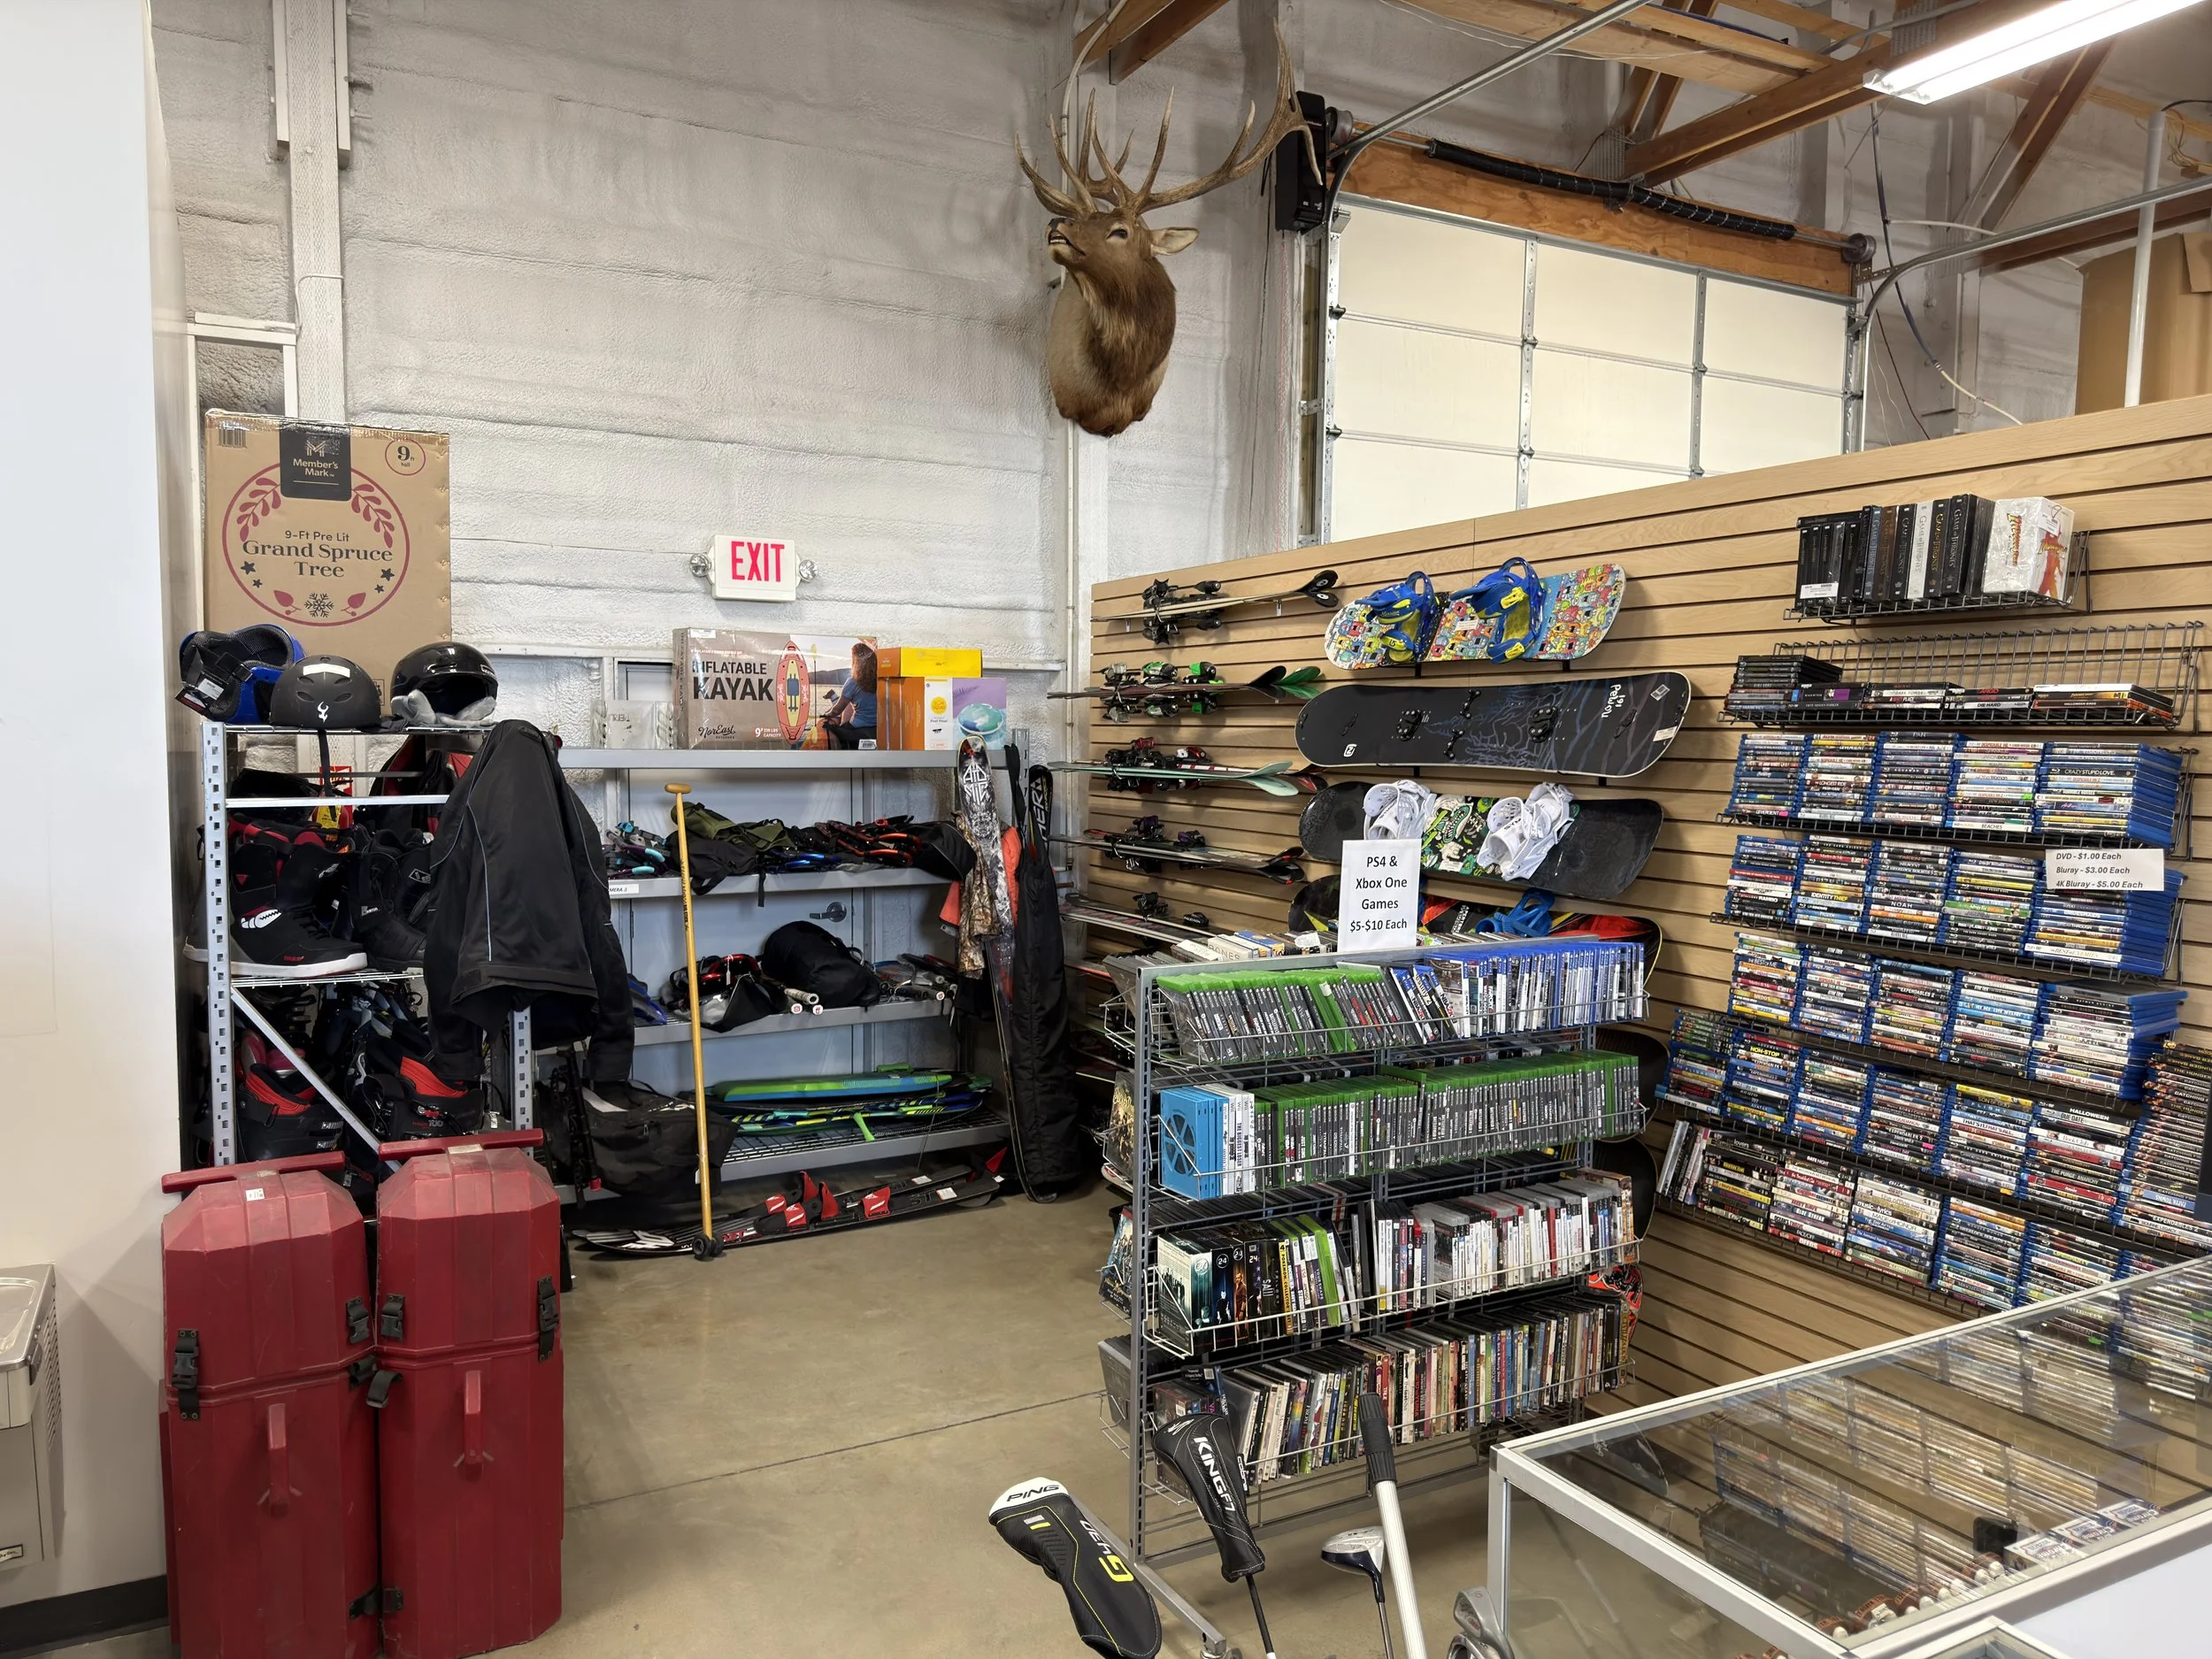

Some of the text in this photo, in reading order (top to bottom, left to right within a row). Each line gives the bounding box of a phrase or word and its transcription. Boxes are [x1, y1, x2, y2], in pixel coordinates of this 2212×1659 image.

[398, 445, 410, 461] 9
[293, 458, 339, 470] Member's
[305, 468, 330, 477] Mark
[284, 530, 349, 542] 9-Ft Pre Lit
[242, 540, 393, 563] Grand Spruce
[730, 540, 785, 583] EXIT
[294, 561, 345, 578] Tree
[692, 661, 767, 675] INFLATABLE
[693, 677, 774, 701] KAYAK
[698, 725, 736, 738] NorEast
[1366, 856, 1398, 868] PS4 &
[2077, 852, 2100, 860] $1.00
[2101, 852, 2122, 860] Each
[2056, 866, 2079, 875] Bluray
[2084, 866, 2108, 874] $3.00
[1356, 877, 1408, 889] Xbox One
[2065, 881, 2090, 889] Bluray
[2096, 880, 2120, 889] $5.00
[2121, 880, 2143, 889] Each
[1361, 898, 1399, 911] Games
[1350, 919, 1407, 933] $5-$10 Each
[1209, 945, 1240, 960] BONES
[1901, 988, 1930, 997] EXPENDABLES
[1440, 993, 1451, 1010] NBA
[1750, 1046, 1780, 1057] NON-STOP
[2175, 1091, 2205, 1102] CATCHING
[1971, 1102, 2006, 1113] FLIGHT
[2070, 1108, 2110, 1121] HALLOWEEN
[1734, 1139, 1749, 1148] lovers
[2077, 1175, 2099, 1185] ANARCHY
[1857, 1201, 1892, 1216] music lyrics
[1872, 1213, 1917, 1231] MADE HONOR
[2152, 1216, 2193, 1230] EXPENDABLES
[1218, 1256, 1227, 1264] 24
[1193, 1436, 1235, 1512] KING F7
[1237, 1456, 1248, 1491] cobra
[1006, 1484, 1060, 1502] PING
